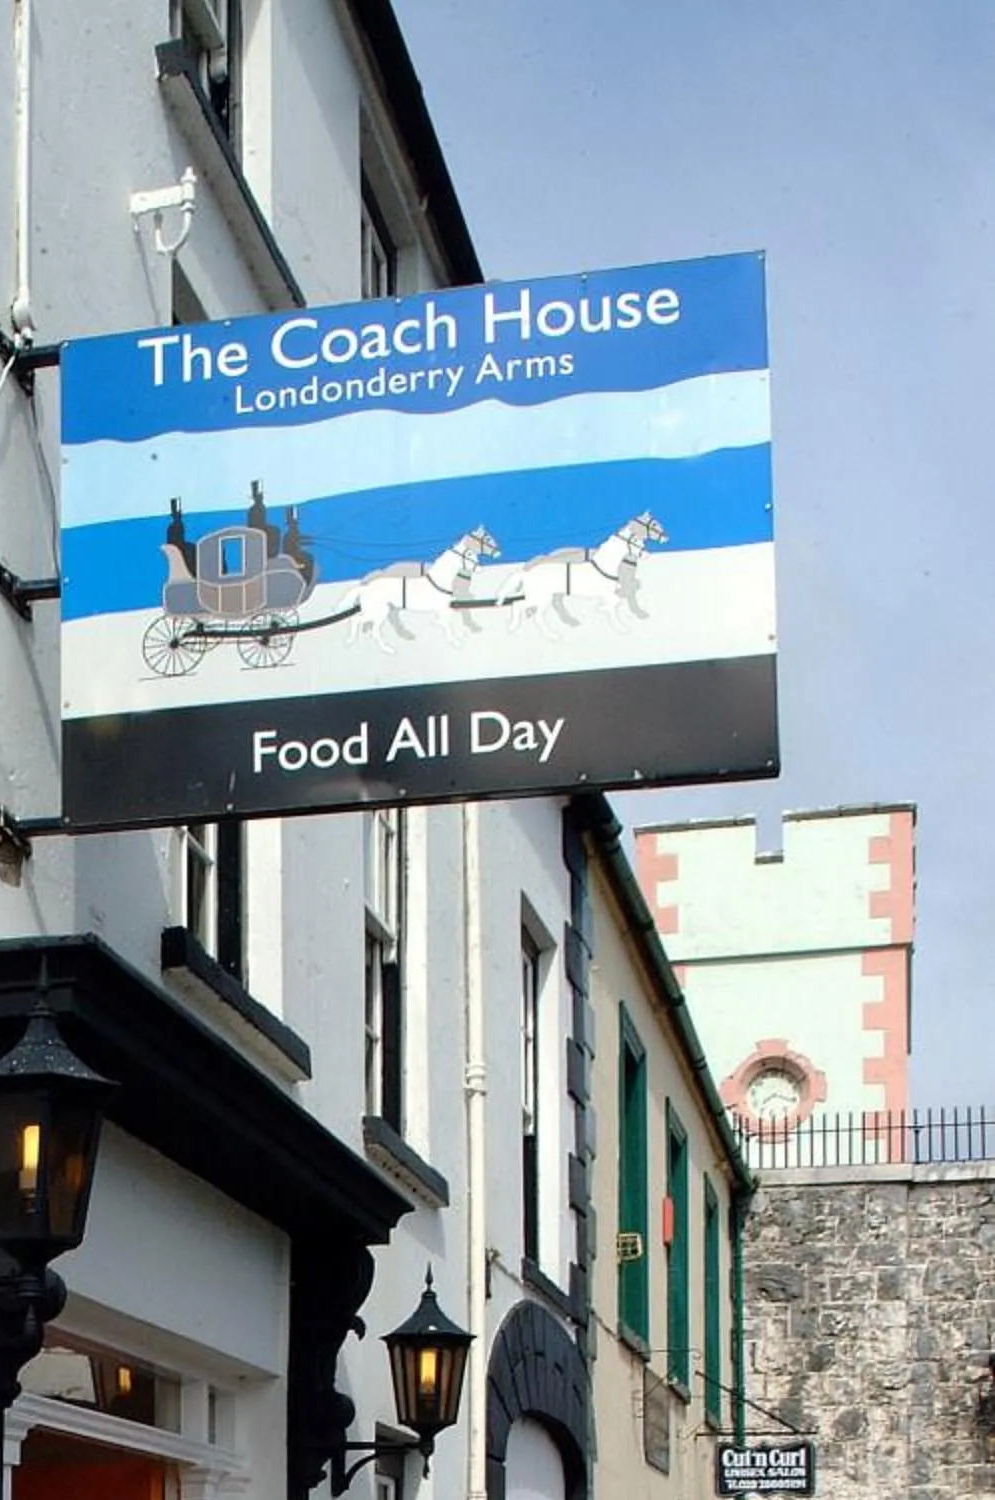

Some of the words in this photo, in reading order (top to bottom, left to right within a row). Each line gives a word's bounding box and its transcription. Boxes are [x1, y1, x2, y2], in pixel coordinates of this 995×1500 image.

[138, 335, 249, 386] The
[270, 311, 456, 370] Coach
[484, 286, 681, 345] House
[235, 365, 463, 414] Londonderry
[475, 350, 575, 385] Arms
[252, 722, 369, 773] Food
[385, 714, 450, 763] All
[470, 711, 566, 763] Day
[768, 1448, 806, 1467] Curl
